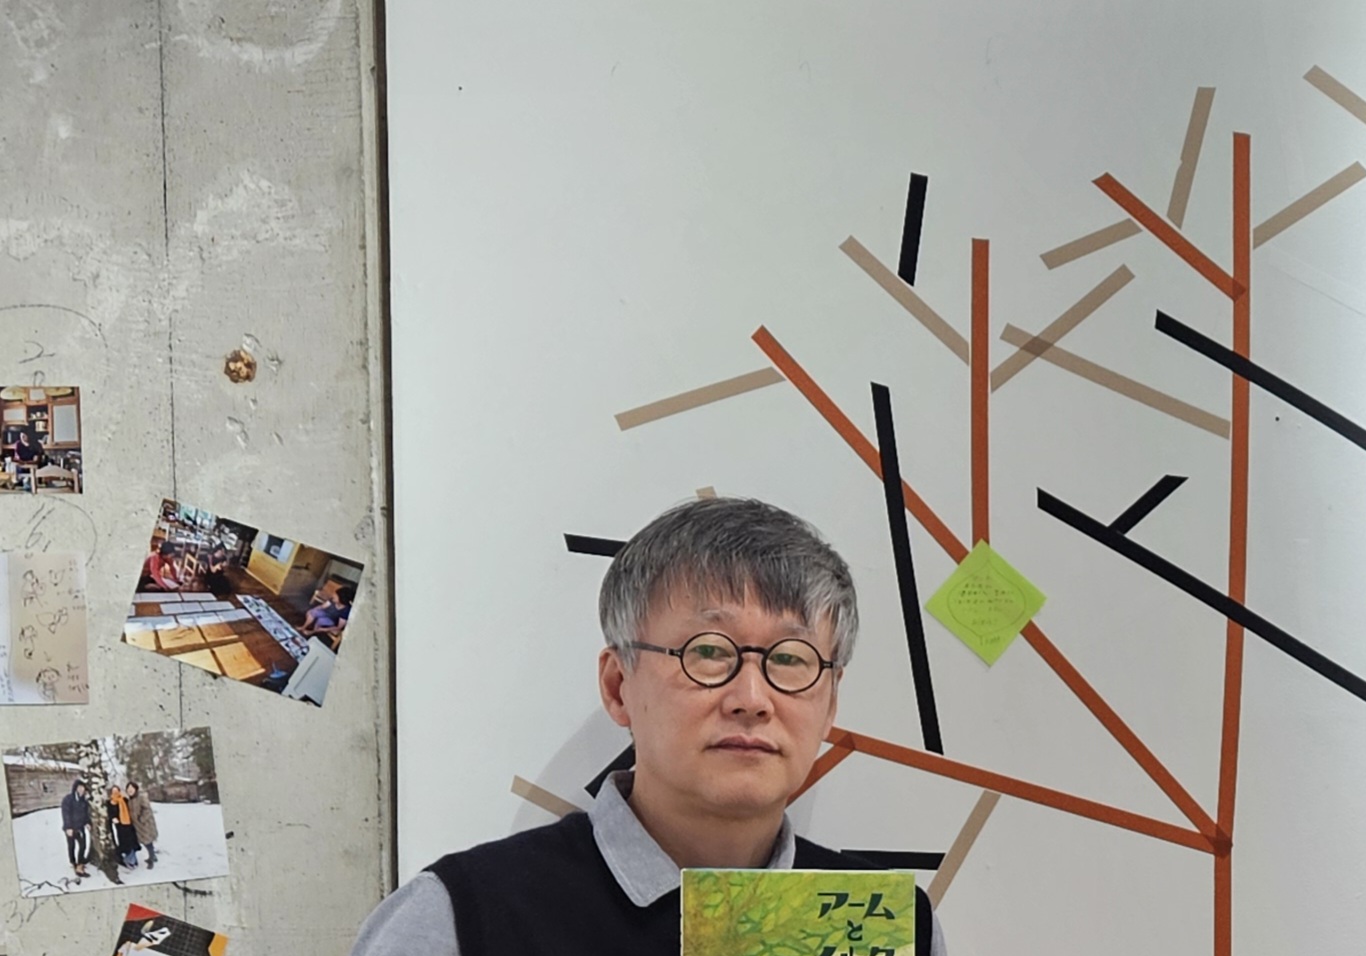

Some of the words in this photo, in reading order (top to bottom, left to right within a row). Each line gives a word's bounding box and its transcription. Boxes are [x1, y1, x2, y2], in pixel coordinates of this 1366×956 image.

[817, 892, 896, 920] アーム
[846, 919, 863, 941] と
